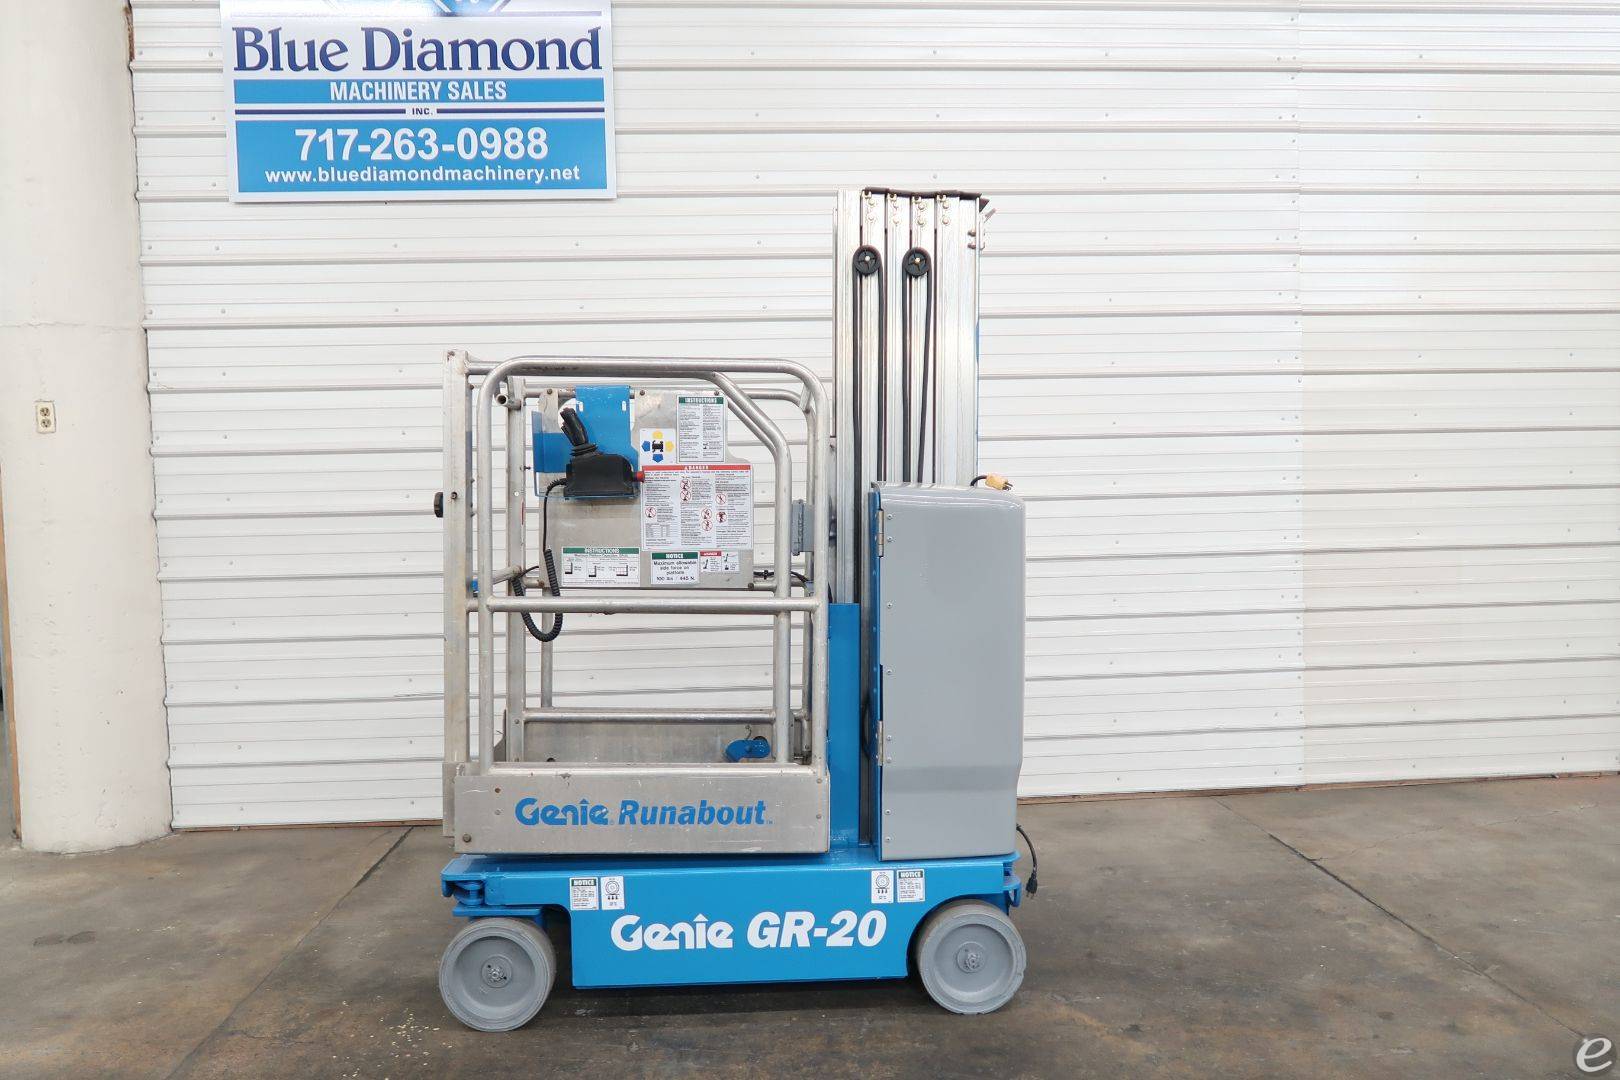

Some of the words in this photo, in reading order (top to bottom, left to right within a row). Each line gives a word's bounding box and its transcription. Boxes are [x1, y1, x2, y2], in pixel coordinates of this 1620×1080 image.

[231, 27, 349, 72] Blue
[361, 26, 602, 72] Diamond
[329, 81, 441, 101] MACHINERY
[447, 81, 507, 100] SALES
[411, 107, 434, 116] INC.
[295, 127, 549, 161] 717-263-0988
[265, 165, 580, 184] www.bluediamondmachinery.net
[515, 798, 609, 826] Genie
[618, 799, 766, 826] Runabout
[610, 913, 734, 951] Genie
[747, 909, 887, 949] GR-20
